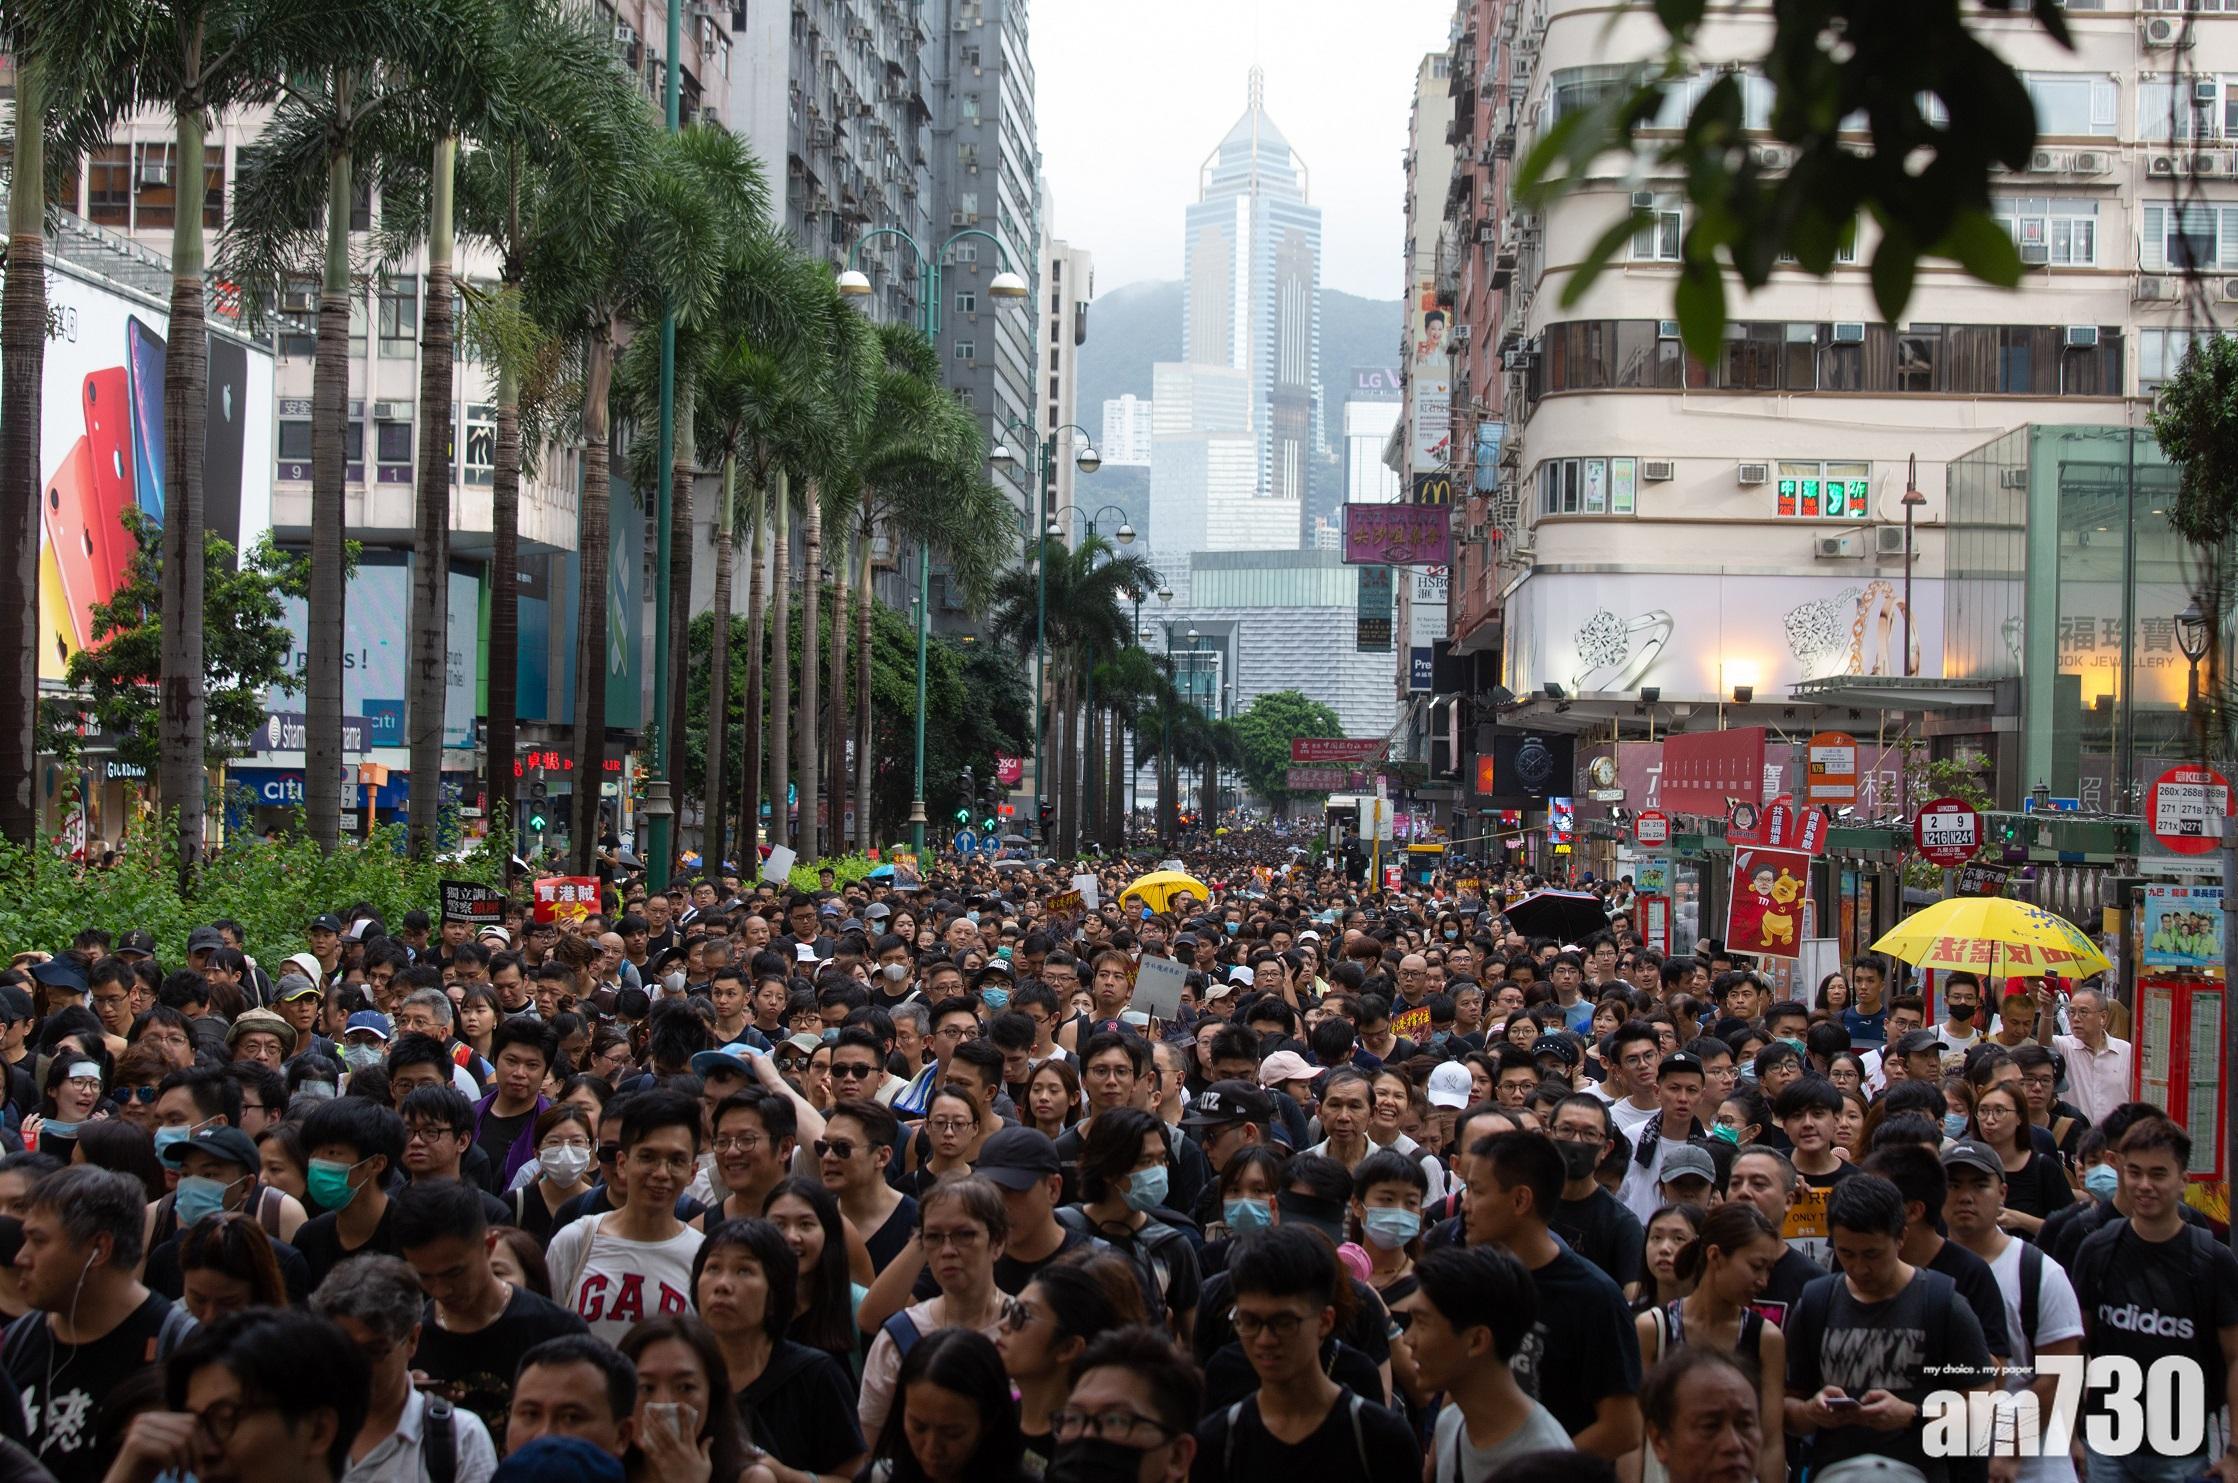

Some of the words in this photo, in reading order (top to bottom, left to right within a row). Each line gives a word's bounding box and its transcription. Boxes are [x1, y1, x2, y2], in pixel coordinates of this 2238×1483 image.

[1359, 373, 1381, 388] LG
[292, 466, 302, 480] 9
[2161, 804, 2176, 813] 271
[1931, 816, 1938, 828] 2
[1958, 816, 1964, 827] 9
[2180, 822, 2201, 831] N271
[1924, 831, 1948, 845] N216
[1949, 831, 1973, 844] N241
[540, 885, 595, 902] 賣港賊
[1793, 1213, 1816, 1222] ONLY
[2099, 1303, 2195, 1339] adidas
